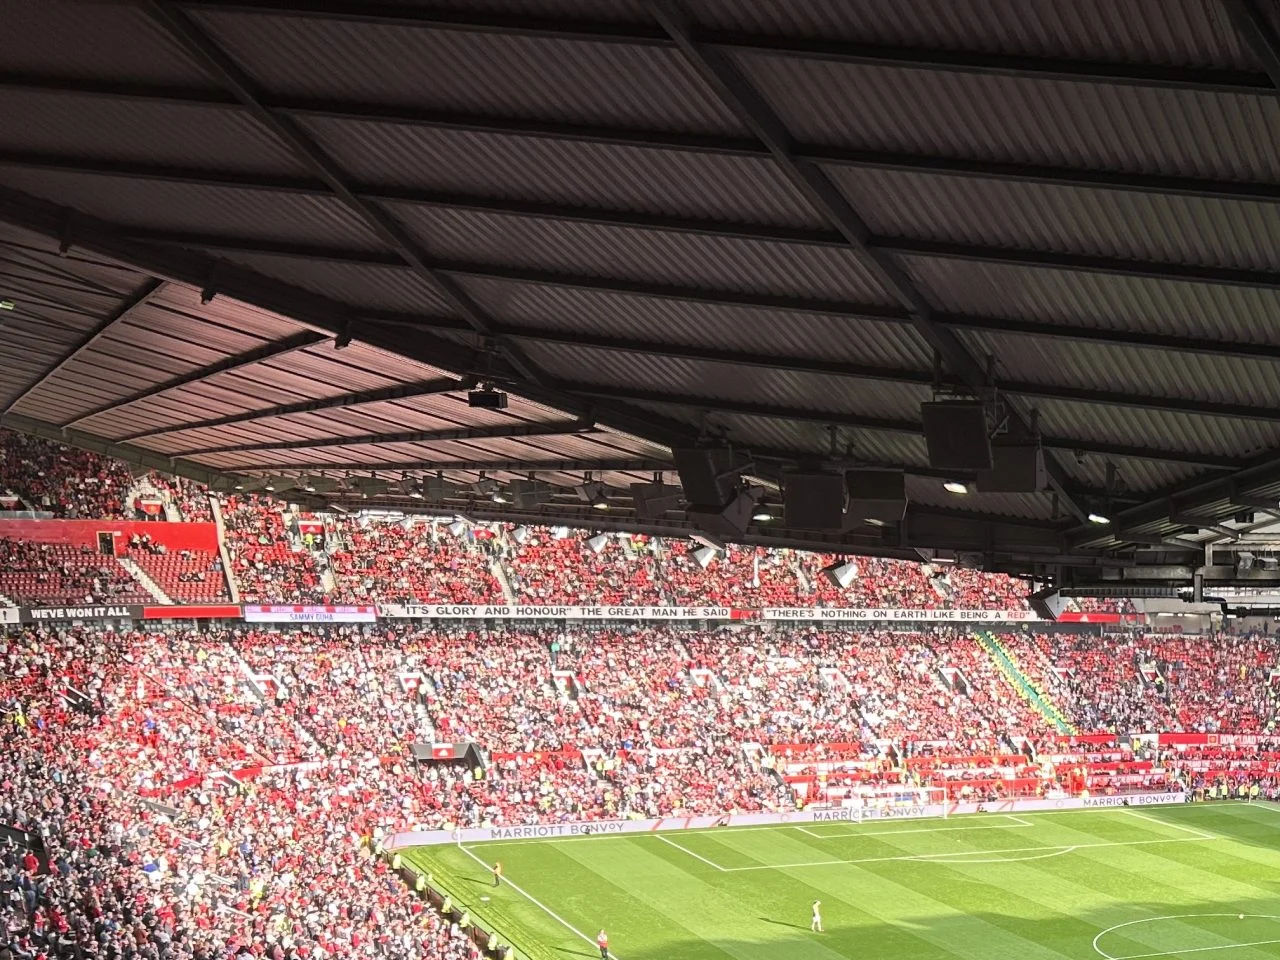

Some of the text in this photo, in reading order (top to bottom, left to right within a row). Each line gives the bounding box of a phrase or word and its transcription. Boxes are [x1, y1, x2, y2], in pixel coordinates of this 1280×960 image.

[31, 606, 130, 619] WE'VE WON IT ALL
[436, 606, 477, 616] GLORY
[485, 606, 510, 616] AND
[580, 607, 602, 616] THE
[608, 607, 645, 616] GREAT
[652, 608, 677, 617] MAN
[683, 608, 697, 617] HE
[703, 608, 728, 617] SAID
[821, 610, 867, 618] NOTHING
[873, 610, 887, 618] ON
[894, 610, 927, 619] EARTH
[933, 610, 954, 619] LIKE
[960, 611, 989, 619] BEING
[995, 611, 1001, 619] A
[491, 823, 564, 839] MARRIOTT
